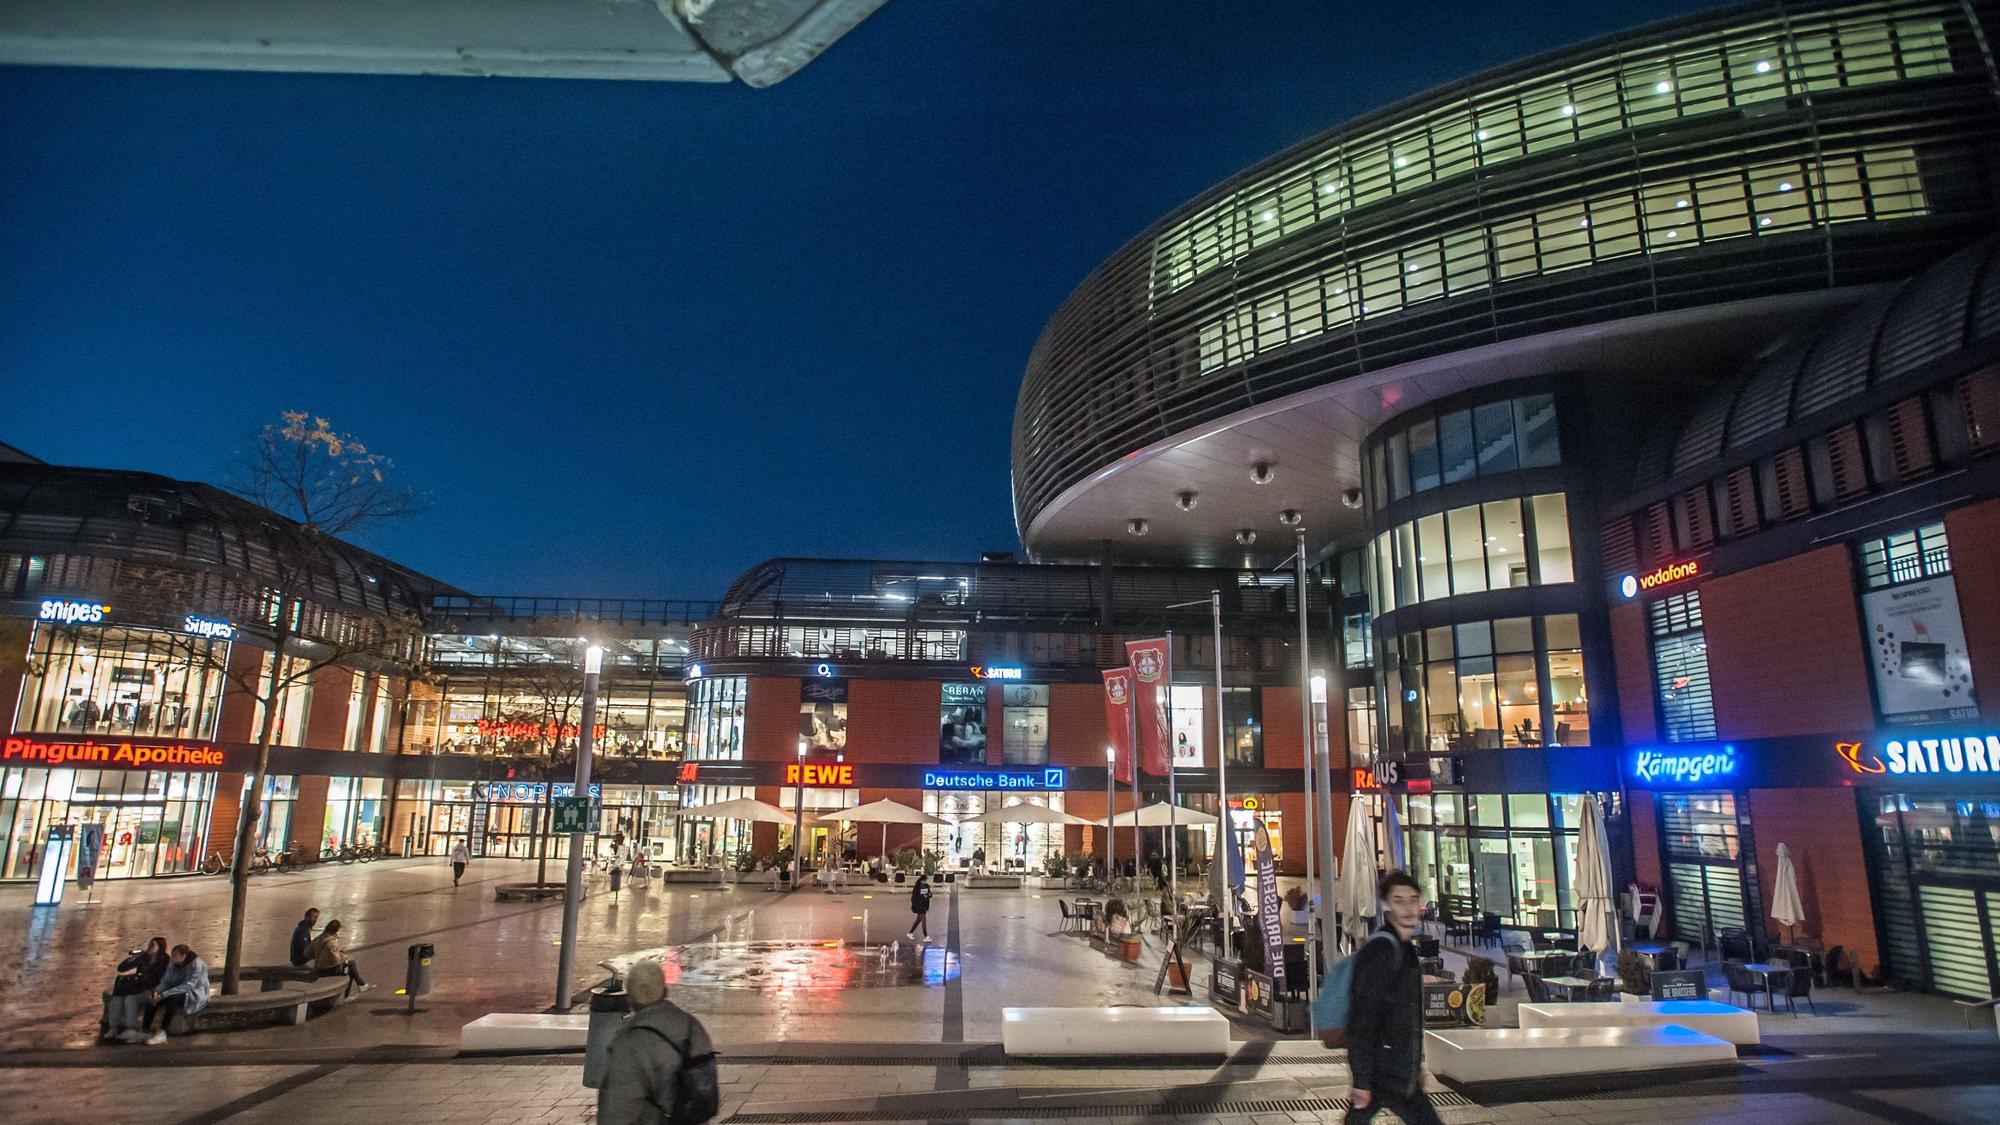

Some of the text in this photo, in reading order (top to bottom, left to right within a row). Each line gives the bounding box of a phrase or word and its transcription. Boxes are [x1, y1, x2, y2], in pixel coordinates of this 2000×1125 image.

[1640, 560, 1698, 589] vodafone
[40, 601, 103, 624] snipes
[987, 667, 1022, 679] SATURN
[3, 739, 224, 766] Pinguin Apotheke
[787, 764, 853, 785] REWE
[1636, 752, 1733, 783] Kämpgen
[925, 773, 1035, 787] Deutsche Bank
